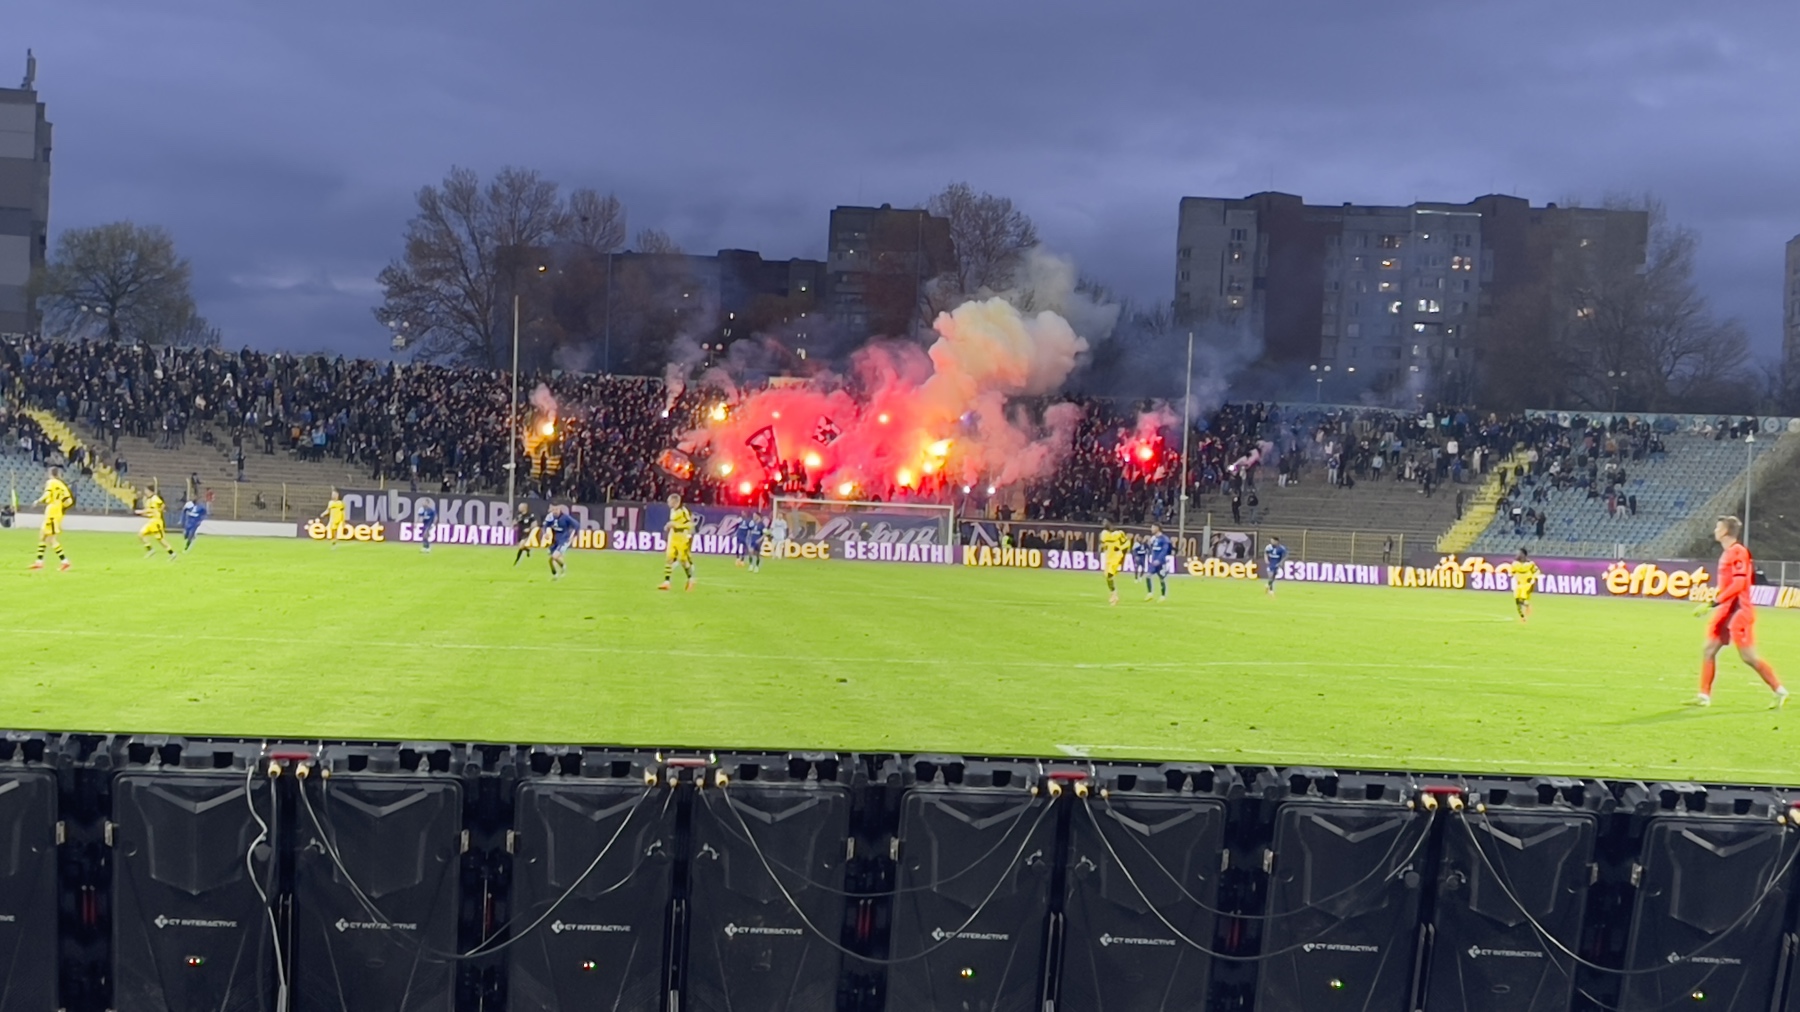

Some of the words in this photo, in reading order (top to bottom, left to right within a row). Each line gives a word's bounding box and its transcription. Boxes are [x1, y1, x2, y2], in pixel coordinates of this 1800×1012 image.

[962, 545, 1041, 567] КАЗИНО
[1387, 566, 1465, 588] КАЗИНО
[181, 919, 237, 928] INTERACTIVE
[577, 924, 631, 932] INTERACTIVE
[750, 927, 803, 935] INTERACTIVE
[1124, 937, 1176, 946] INTERACTIVE
[1327, 944, 1378, 953] INTERACTIVE
[1492, 950, 1543, 958] INTERACTIVE
